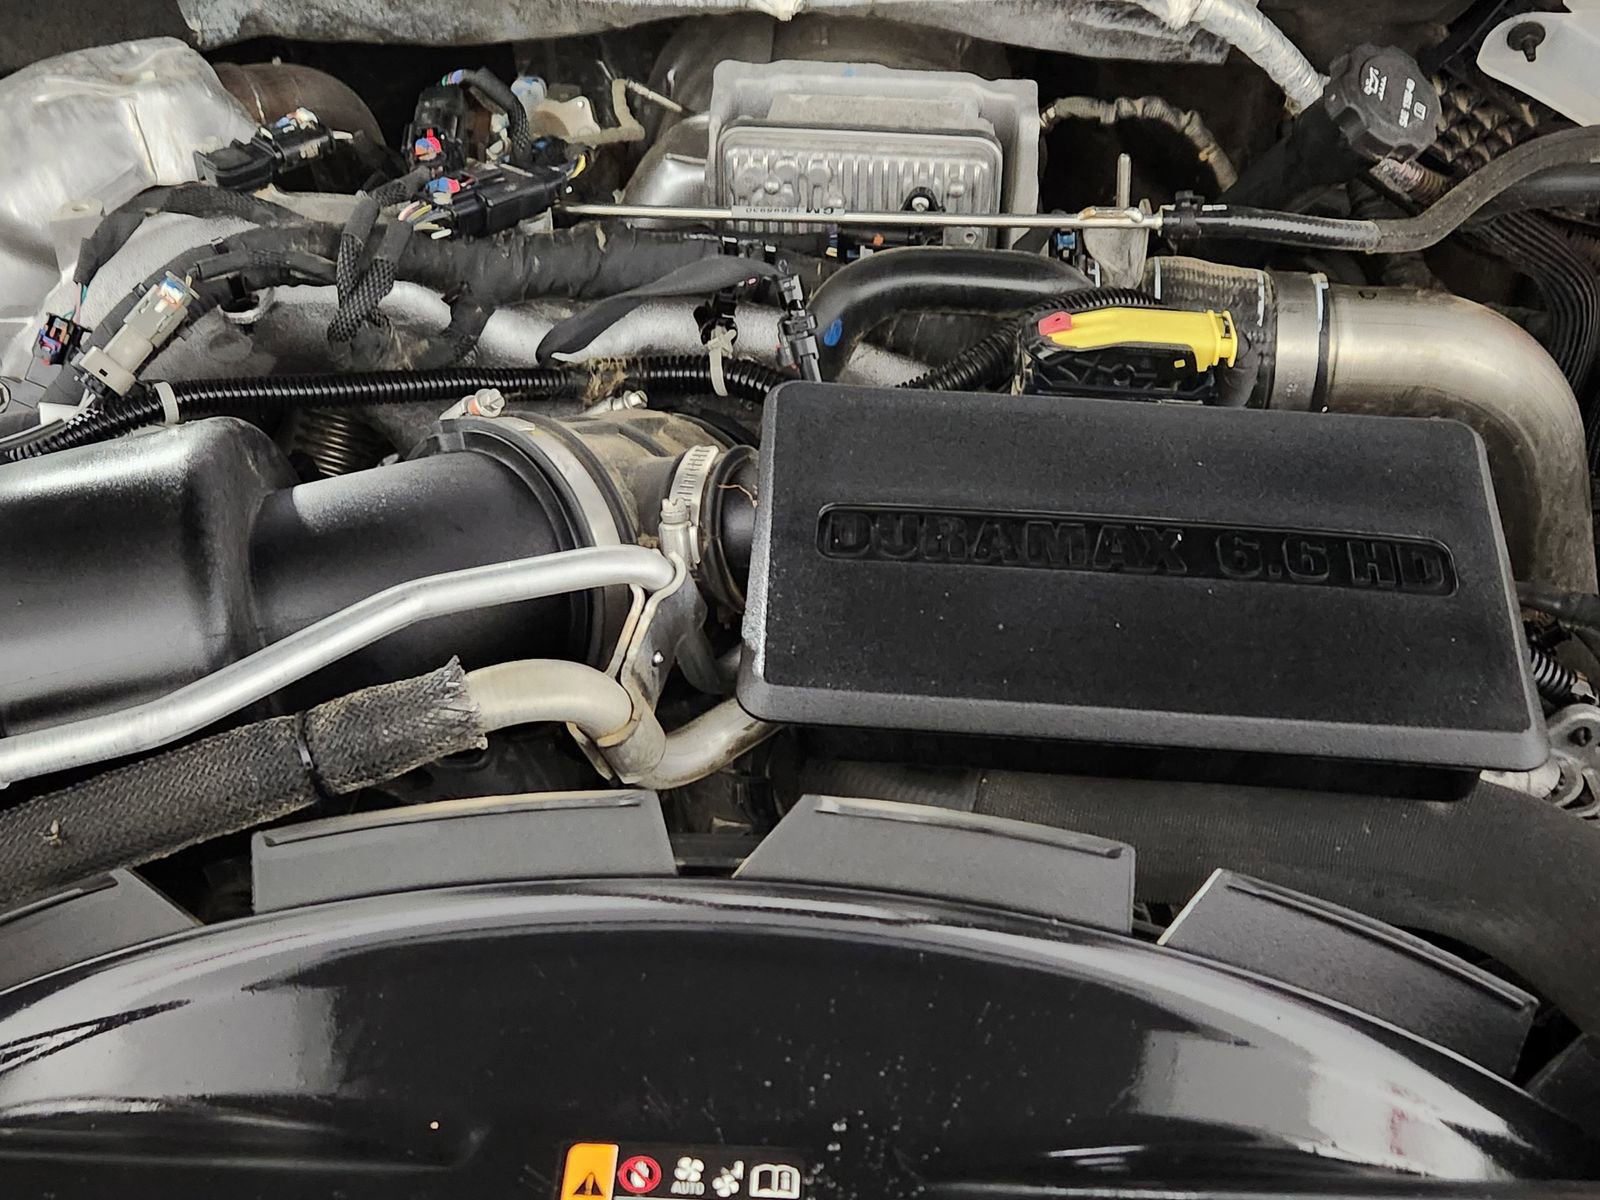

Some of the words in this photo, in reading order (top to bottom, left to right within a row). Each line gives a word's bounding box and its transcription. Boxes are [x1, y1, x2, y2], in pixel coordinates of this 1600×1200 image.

[824, 511, 1188, 575] DURAMAX
[1216, 531, 1330, 582] 6.6
[1346, 541, 1446, 586] HD
[671, 1181, 705, 1195] AUTO
